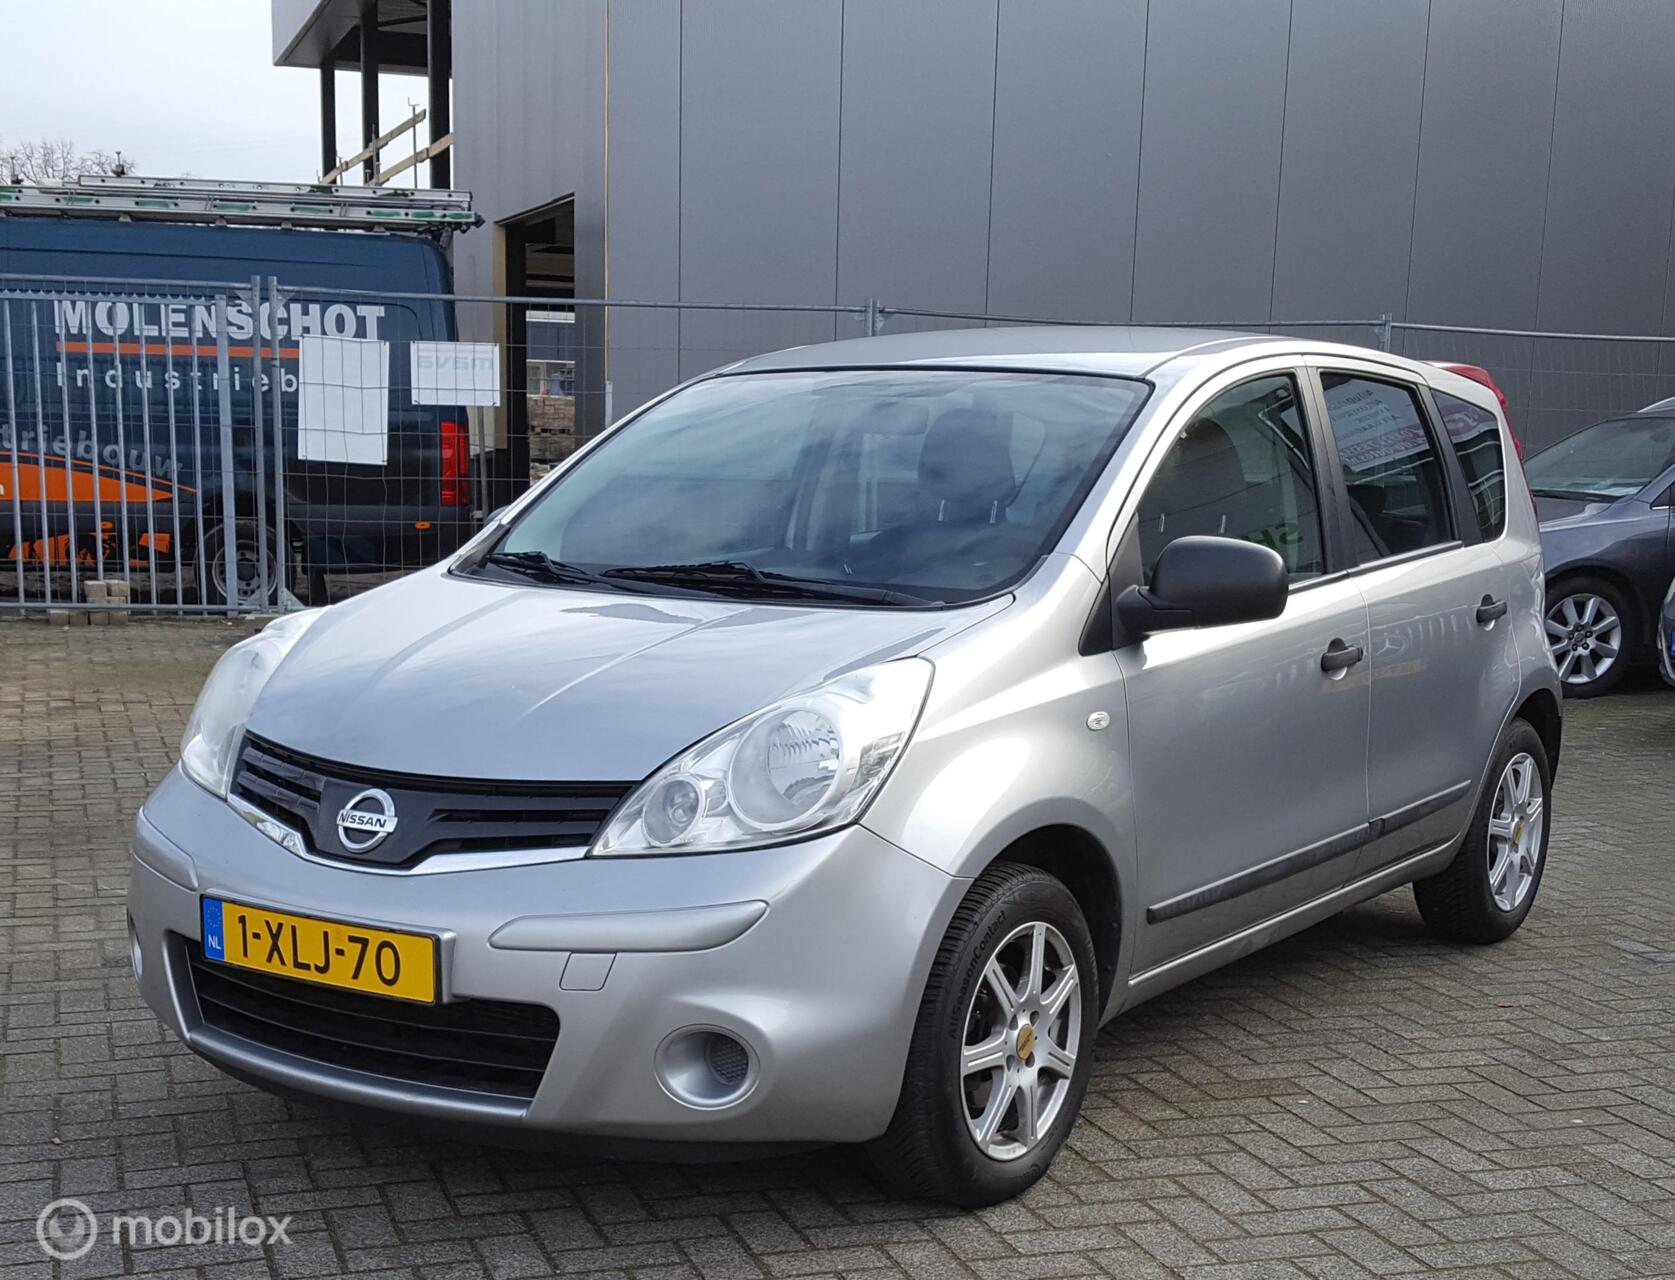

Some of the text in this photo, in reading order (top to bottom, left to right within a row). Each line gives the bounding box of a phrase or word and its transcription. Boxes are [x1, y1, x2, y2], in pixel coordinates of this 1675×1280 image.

[54, 299, 385, 341] MOLENSCHOT
[338, 811, 387, 829] NISSAN
[207, 914, 401, 986] NL 1-XLJ-70
